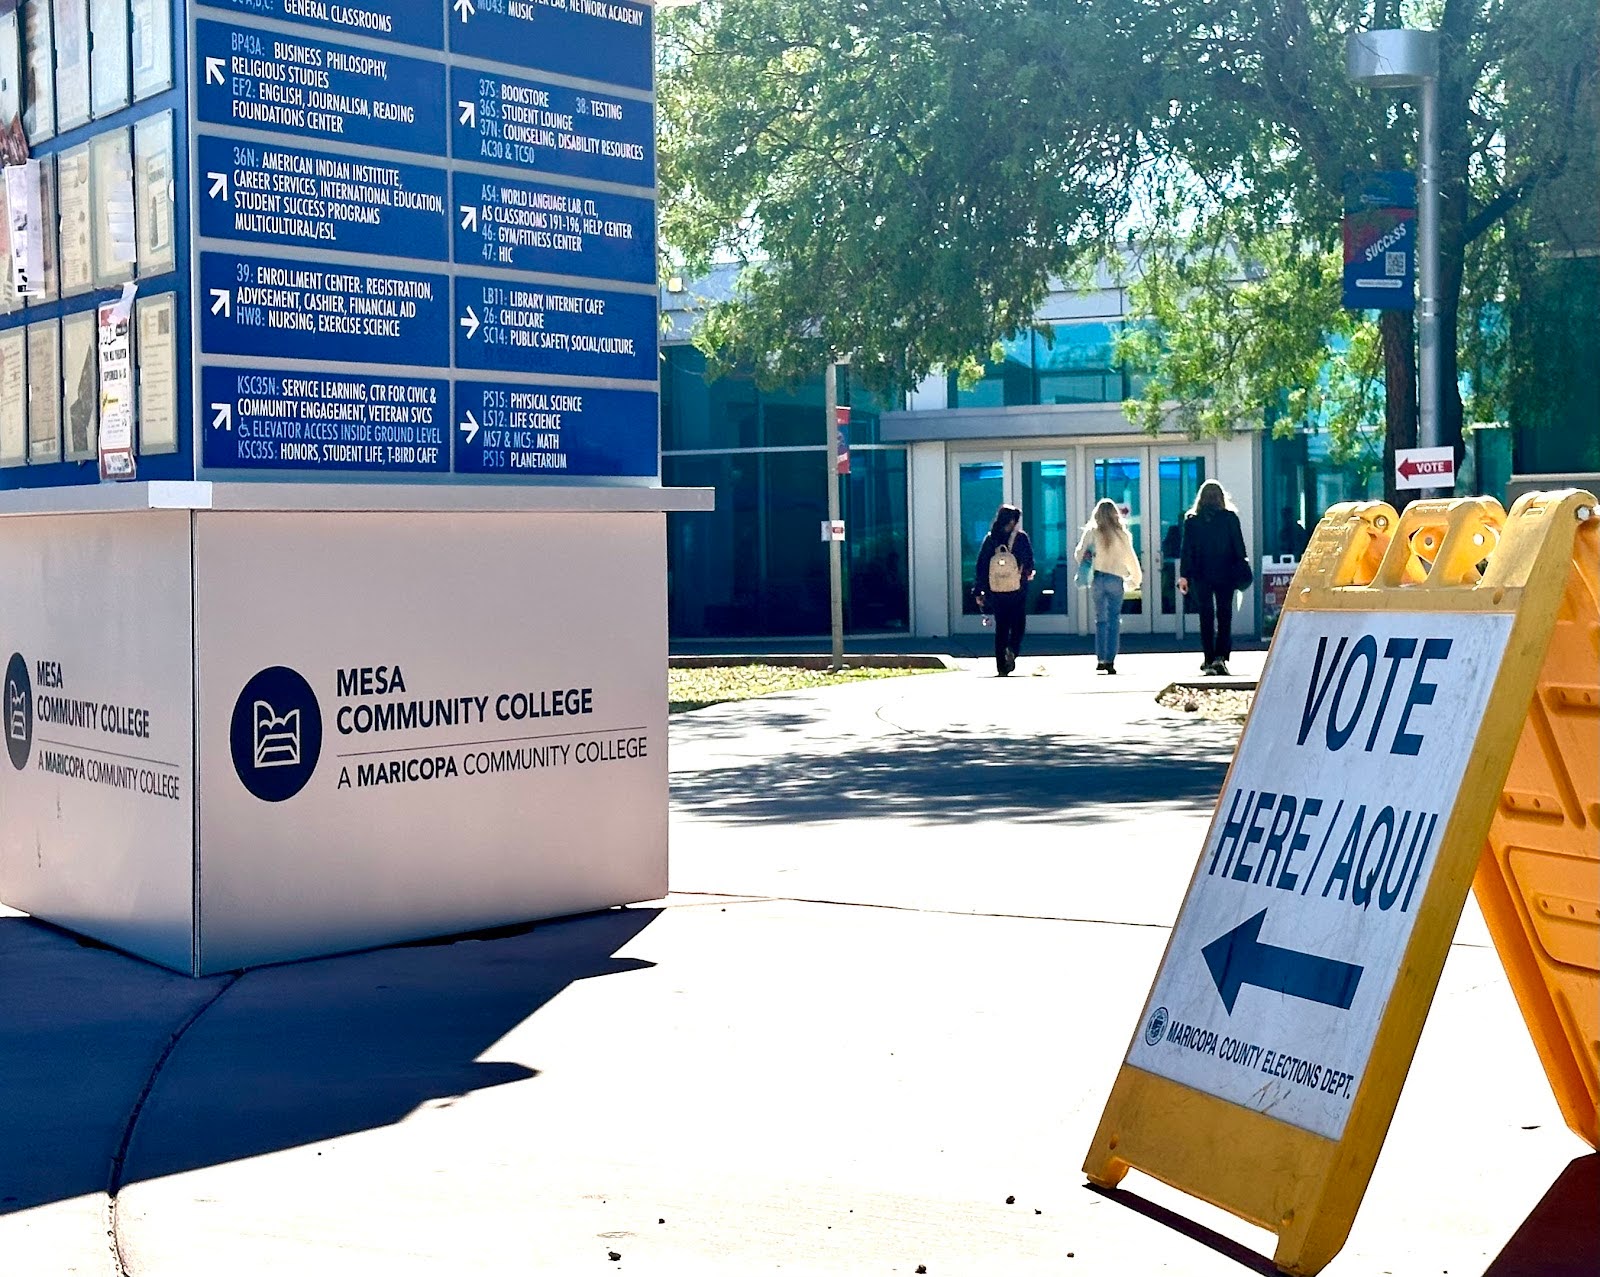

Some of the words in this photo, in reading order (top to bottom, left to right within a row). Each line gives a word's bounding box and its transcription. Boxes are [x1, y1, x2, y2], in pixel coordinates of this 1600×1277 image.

[285, 0, 328, 21] GENERAL
[331, 6, 392, 32] CLASSROOMS
[508, 2, 534, 21] MUSIC
[570, 0, 607, 18] NETWORK
[608, 8, 643, 26] ACADEMY
[231, 32, 265, 56] BP43A:
[274, 42, 321, 66] BUSINESS
[327, 52, 387, 80] PHILOSOPHY,
[232, 56, 285, 81] RELIGIOUS
[288, 66, 329, 88] STUDIES
[233, 77, 256, 98] EF2:
[259, 83, 305, 109] ENGLISH,
[308, 91, 371, 118] JOURNALISM,
[374, 102, 414, 123] READING
[479, 79, 498, 98] 37S:
[502, 84, 549, 108] BOOKSTORE
[591, 100, 622, 120] TESTING
[480, 99, 498, 119] 36S:
[502, 105, 539, 125] STUDENT
[541, 112, 573, 131] LOUNGE
[233, 102, 304, 127] FOUNDATIONS
[307, 114, 343, 133] CENTER
[480, 120, 500, 136] 37N:
[503, 124, 557, 149] COUNSELING,
[558, 133, 600, 154] DISABILITY
[602, 140, 644, 161] RESOURCES
[481, 139, 502, 158] AC30
[505, 144, 512, 160] &
[514, 144, 534, 163] TC50
[234, 147, 259, 168] 36N:
[262, 152, 313, 175] AMERICAN
[316, 159, 349, 180] INDIAN
[353, 165, 402, 189] INSTITUTE,
[234, 170, 270, 190] CAREER
[273, 175, 318, 198] SERVICES,
[321, 182, 391, 206] INTERNATIONAL
[394, 191, 445, 216] EDUCATION,
[235, 191, 281, 212] STUDENT
[283, 198, 325, 218] SUCCESS
[328, 204, 380, 224] PROGRAMS
[481, 184, 499, 202] AS4:
[501, 188, 527, 206] WORLD
[529, 193, 567, 212] LANGUAGE
[568, 198, 583, 216] LAB,
[585, 200, 598, 217] CTL,
[235, 213, 336, 240] MULTICULTURAL/ESL
[482, 205, 492, 221] AS
[494, 207, 547, 228] CLASSROOMS
[550, 215, 581, 235] 191-196,
[583, 219, 603, 235] HELP
[605, 222, 632, 239] CENTER
[482, 225, 496, 241] 46:
[499, 227, 551, 248] GYM/FITNESS
[553, 236, 582, 252] CENTER
[482, 244, 496, 261] 47:
[499, 246, 513, 263] HIC
[1365, 222, 1406, 262] SUCCESS
[237, 264, 253, 283] 39:
[257, 266, 322, 290] ENROLLMENT
[325, 275, 363, 294] CENTER:
[366, 279, 433, 301] REGISTRATION,
[237, 287, 302, 312] ADVISEMENT,
[304, 294, 347, 315] CASHIER,
[350, 297, 398, 317] FINANCIAL
[400, 301, 415, 318] AID
[483, 287, 507, 304] LB11:
[510, 291, 544, 312] LIBRARY,
[546, 295, 583, 313] INTERNET
[237, 306, 265, 327] HW8:
[268, 310, 316, 333] NURSING,
[319, 315, 361, 334] EXERCISE
[363, 319, 400, 336] SCIENCE
[484, 307, 497, 324] 26:
[500, 310, 544, 328] CHILDCARE
[484, 327, 507, 344] SC14:
[511, 332, 539, 348] PUBLIC
[541, 333, 569, 352] SAFETY,
[572, 335, 636, 356] SOCIAL/CULTURE,
[237, 375, 279, 396] KSC35N:
[282, 379, 319, 398] SERVICE
[321, 382, 367, 403] LEARNING,
[370, 385, 386, 401] CTR
[388, 386, 405, 402] FOR
[407, 387, 428, 403] CIVIC
[430, 388, 436, 403] &
[483, 391, 508, 408] PS15:
[511, 393, 549, 411] PHYSICAL
[551, 395, 582, 412] SCIENCE
[238, 399, 298, 418] COMMUNITY
[301, 402, 366, 424] ENGAGEMENT,
[369, 405, 409, 423] VETERAN
[411, 407, 432, 424] SVCS
[483, 410, 507, 427] LS12:
[510, 412, 527, 428] LIFE
[529, 414, 561, 429] SCIENCE
[253, 421, 301, 439] ELEVATOR
[304, 423, 338, 440] ACCESS
[341, 425, 372, 441] INSIDE
[375, 426, 414, 443] GROUND
[416, 428, 442, 444] LEVEL
[483, 431, 502, 447] MS7
[504, 432, 511, 447] &
[536, 434, 559, 449] MATH
[238, 441, 278, 459] KSC35S:
[281, 443, 321, 463] HONORS,
[323, 445, 362, 462] STUDENT
[365, 446, 385, 465] LIFE,
[387, 447, 415, 463] T-BIRD
[483, 450, 504, 467] PS15
[511, 452, 567, 468] PLANETARIUM
[1416, 462, 1445, 473] VOTE
[37, 661, 63, 689] MESA
[336, 665, 406, 697] MESA
[1297, 634, 1453, 756] VOTE
[38, 695, 98, 730] COMMUNITY
[101, 704, 149, 738] COLLEGE
[336, 696, 489, 735] COMMUNITY
[495, 688, 593, 720] COLLEGE
[38, 751, 44, 770] A
[46, 751, 85, 779] MARICOPA
[87, 759, 138, 792] COMMUNITY
[140, 770, 179, 800] COLLEGE
[337, 766, 351, 790] A
[357, 755, 458, 787] MARICOPA
[463, 743, 571, 776] COMMUNITY
[575, 737, 648, 765] COLLEGE
[1209, 789, 1323, 891] HERE
[1322, 804, 1438, 912] AQUI
[1166, 1021, 1219, 1055] MARICOPA
[1219, 1037, 1264, 1069] COUNTY
[1261, 1050, 1322, 1088] ELECTIONS
[1320, 1068, 1354, 1099] DEPT.
